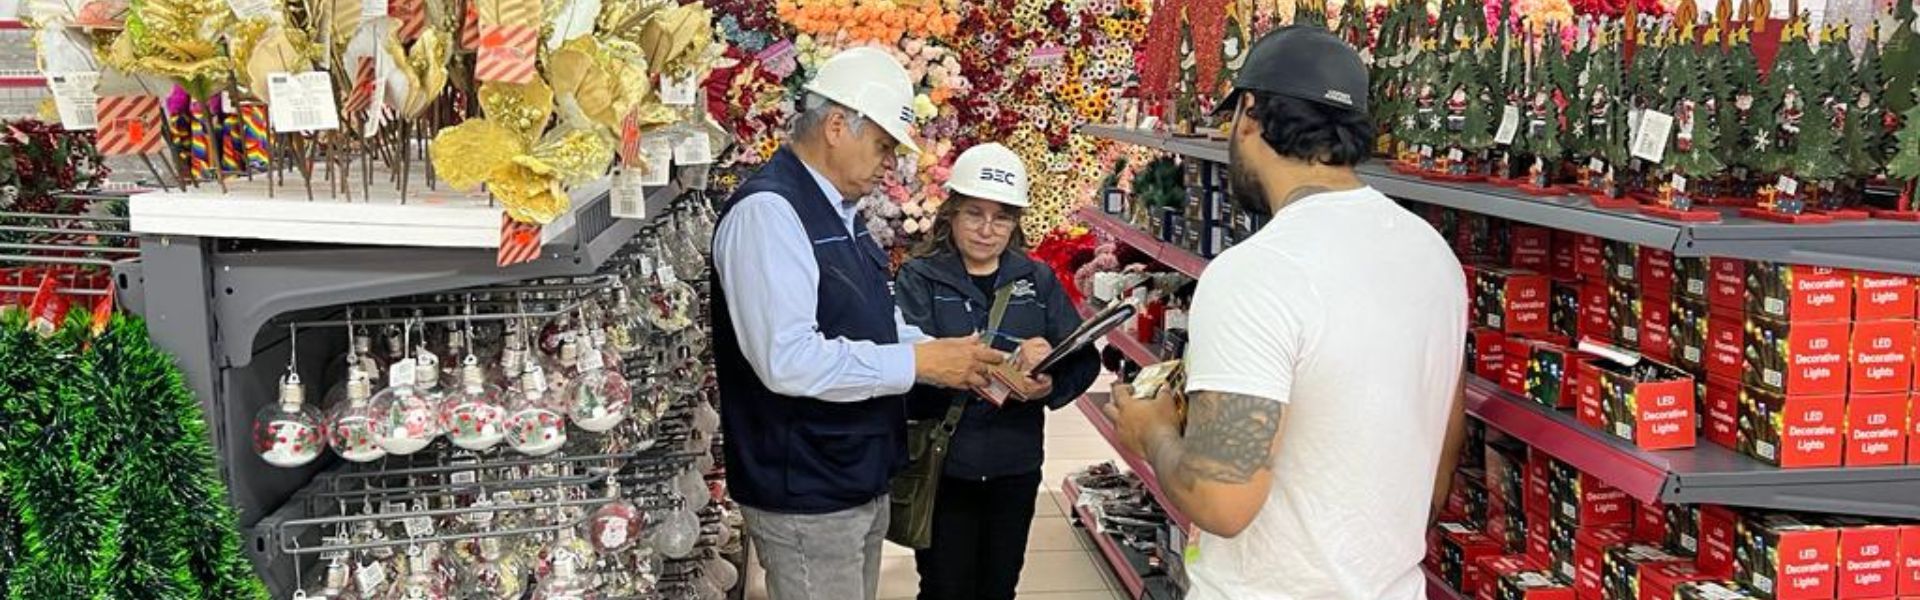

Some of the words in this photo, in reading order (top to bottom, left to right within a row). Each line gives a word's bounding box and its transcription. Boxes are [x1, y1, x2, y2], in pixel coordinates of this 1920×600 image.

[980, 167, 1015, 187] SEC
[1798, 279, 1846, 291] Decorative
[1862, 277, 1908, 289] Decorative
[1806, 294, 1836, 306] Lights
[1871, 291, 1899, 305] Lights
[1808, 337, 1830, 350] LED
[1872, 336, 1893, 349] LED
[1795, 353, 1841, 365] Decorative
[1857, 352, 1905, 365] Decorative
[1803, 367, 1831, 380] Lights
[1866, 366, 1895, 380] Lights
[1656, 394, 1676, 406] LED
[1643, 408, 1689, 421] Decorative
[1803, 410, 1824, 422] LED
[1866, 413, 1888, 425] LED
[1651, 422, 1681, 436] Lights
[1788, 425, 1836, 437] Decorative
[1853, 428, 1900, 441] Decorative
[1796, 440, 1826, 452] Lights
[1860, 442, 1889, 456] Lights
[1594, 502, 1620, 514] Lights
[1799, 548, 1819, 560] LED
[1860, 544, 1880, 556] LED
[1784, 562, 1831, 575] Decorative
[1846, 559, 1892, 571] Decorative
[1793, 576, 1821, 590] Lights
[1854, 573, 1883, 586] Lights
